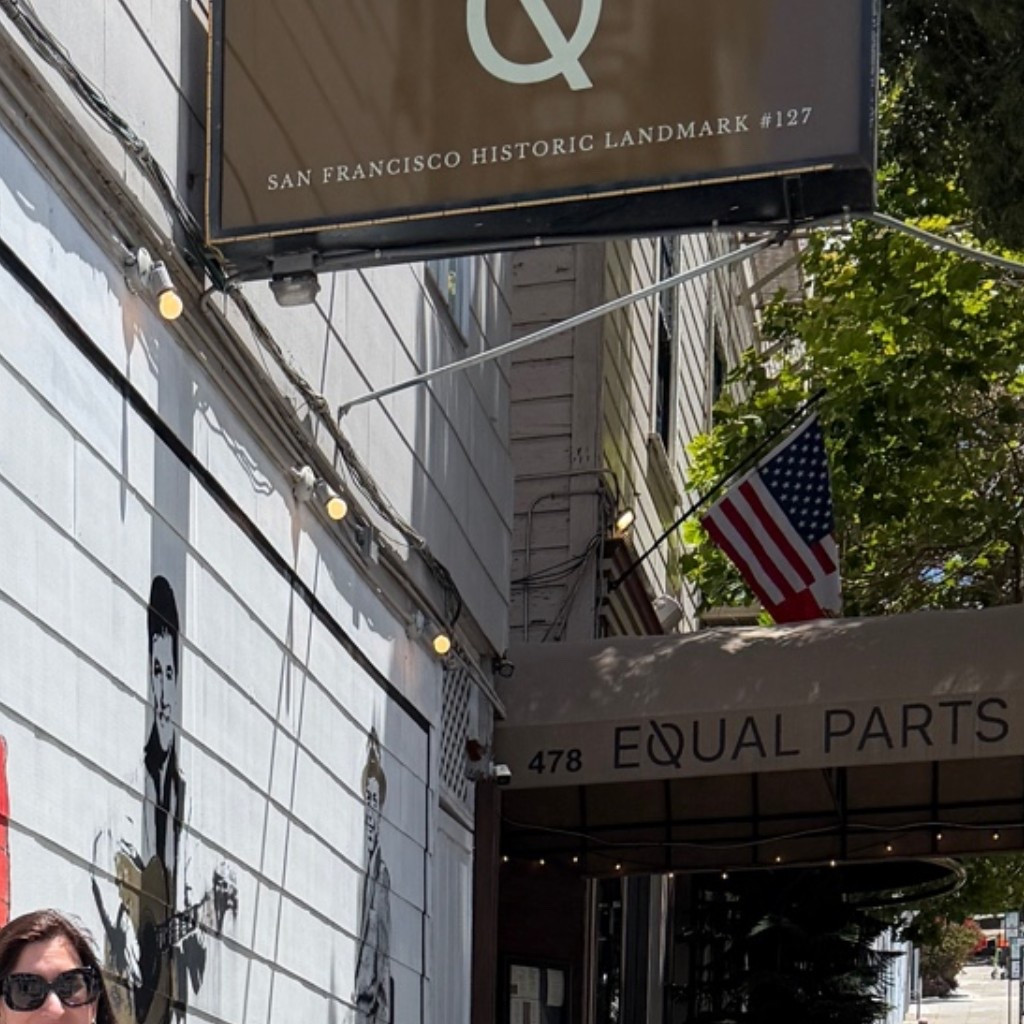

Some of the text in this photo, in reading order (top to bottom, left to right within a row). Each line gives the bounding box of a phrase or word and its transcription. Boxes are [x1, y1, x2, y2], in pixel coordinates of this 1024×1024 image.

[267, 107, 812, 191] SAN FRANCISCO HISTORIC LANDMARK #127
[527, 697, 1010, 774] 478 EQUAL PARTS
